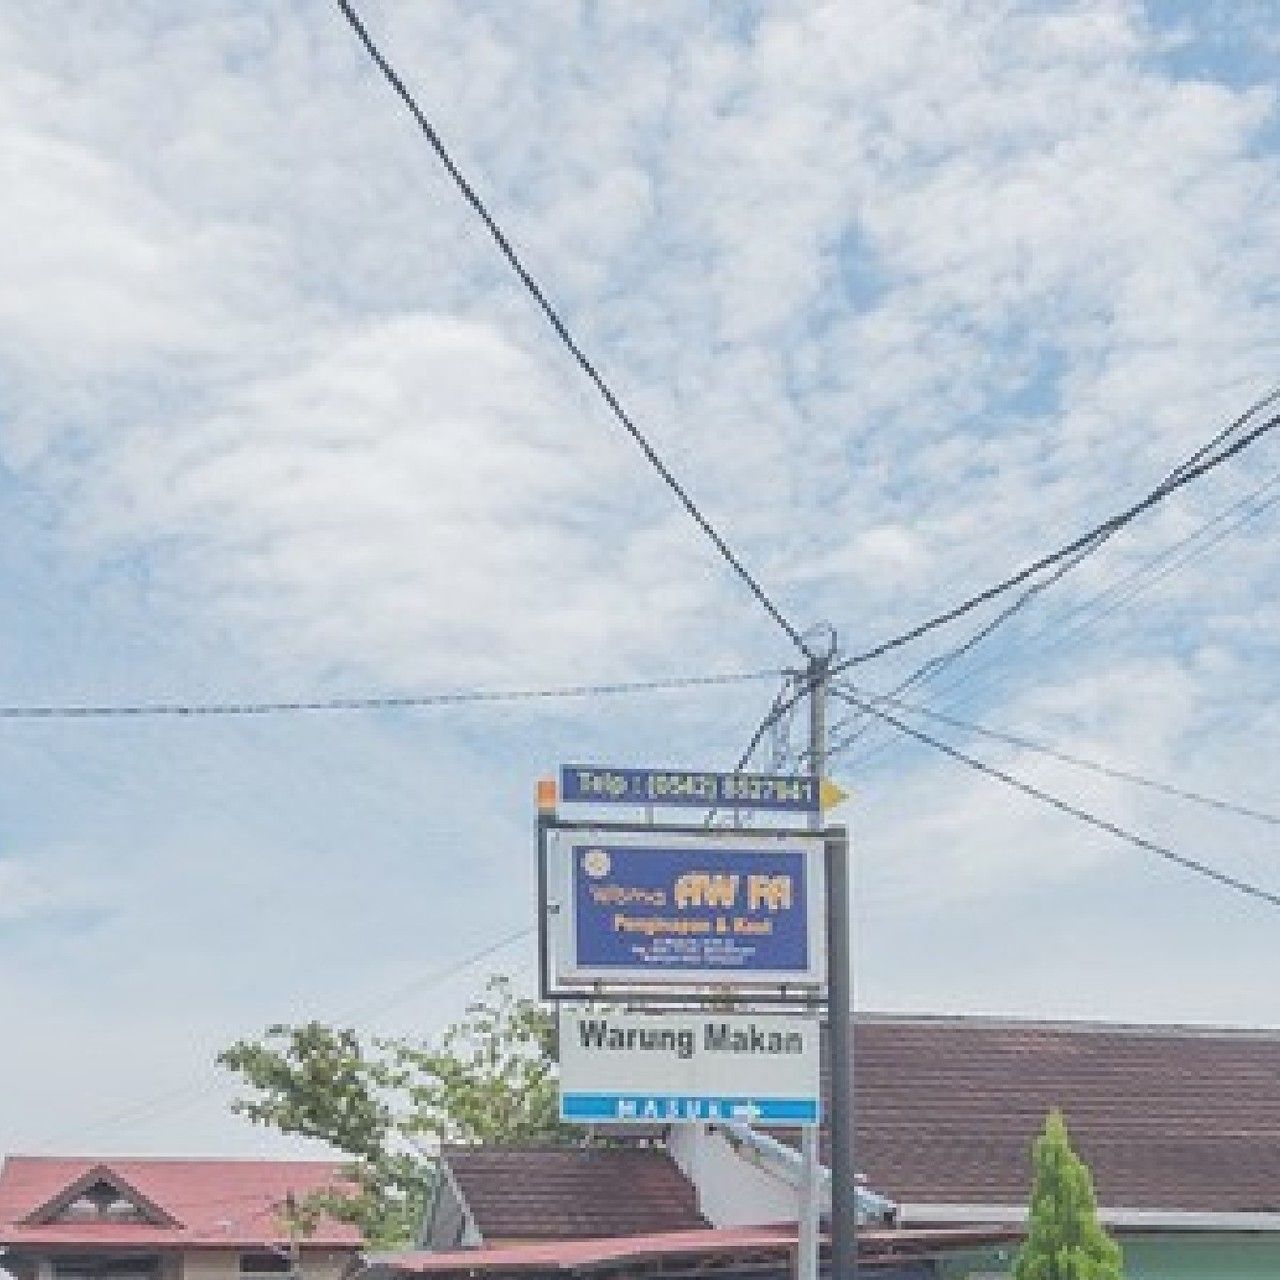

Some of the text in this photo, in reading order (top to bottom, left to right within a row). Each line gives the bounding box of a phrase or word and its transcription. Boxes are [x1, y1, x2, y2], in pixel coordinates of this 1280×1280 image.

[578, 772, 625, 795] Telp
[577, 1019, 803, 1059] Warung Makan
[619, 1099, 719, 1119] MASUK
